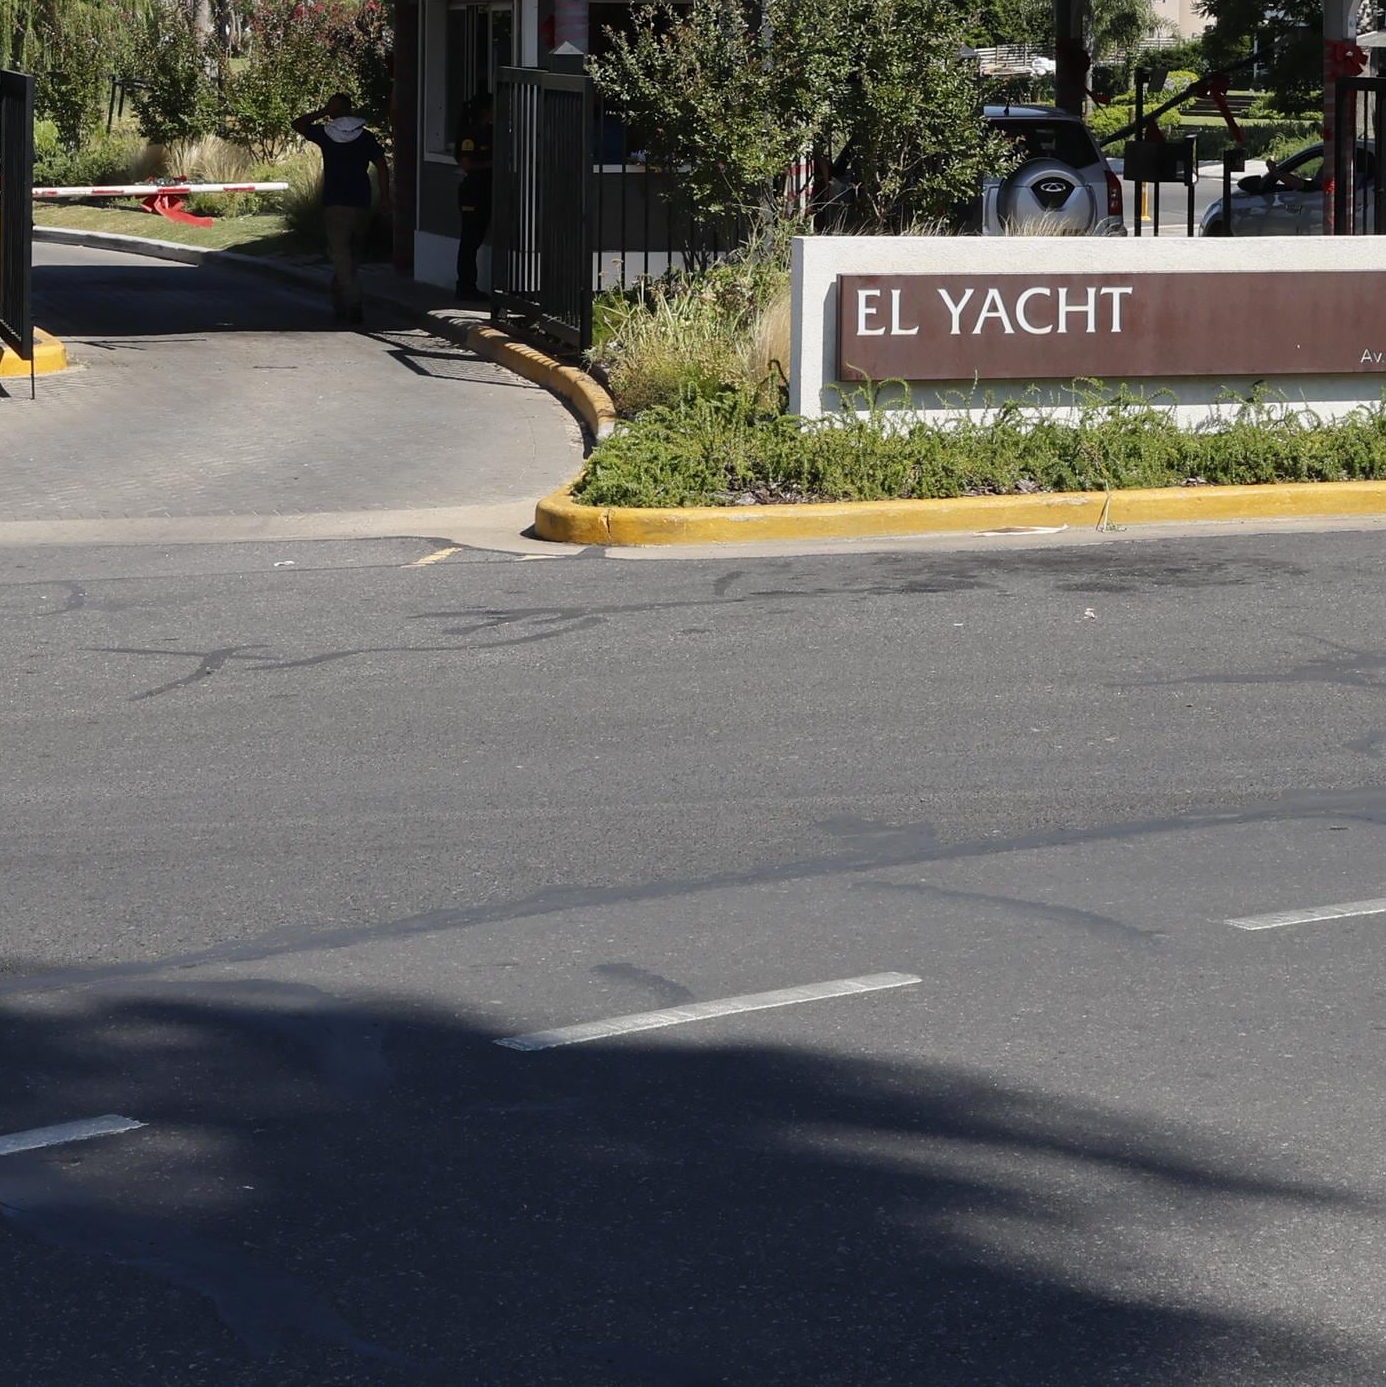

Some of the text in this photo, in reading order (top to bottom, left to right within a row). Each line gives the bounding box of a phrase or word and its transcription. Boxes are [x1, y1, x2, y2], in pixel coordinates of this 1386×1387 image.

[856, 286, 1134, 336] EL YACHT
[1360, 348, 1385, 363] Av.
